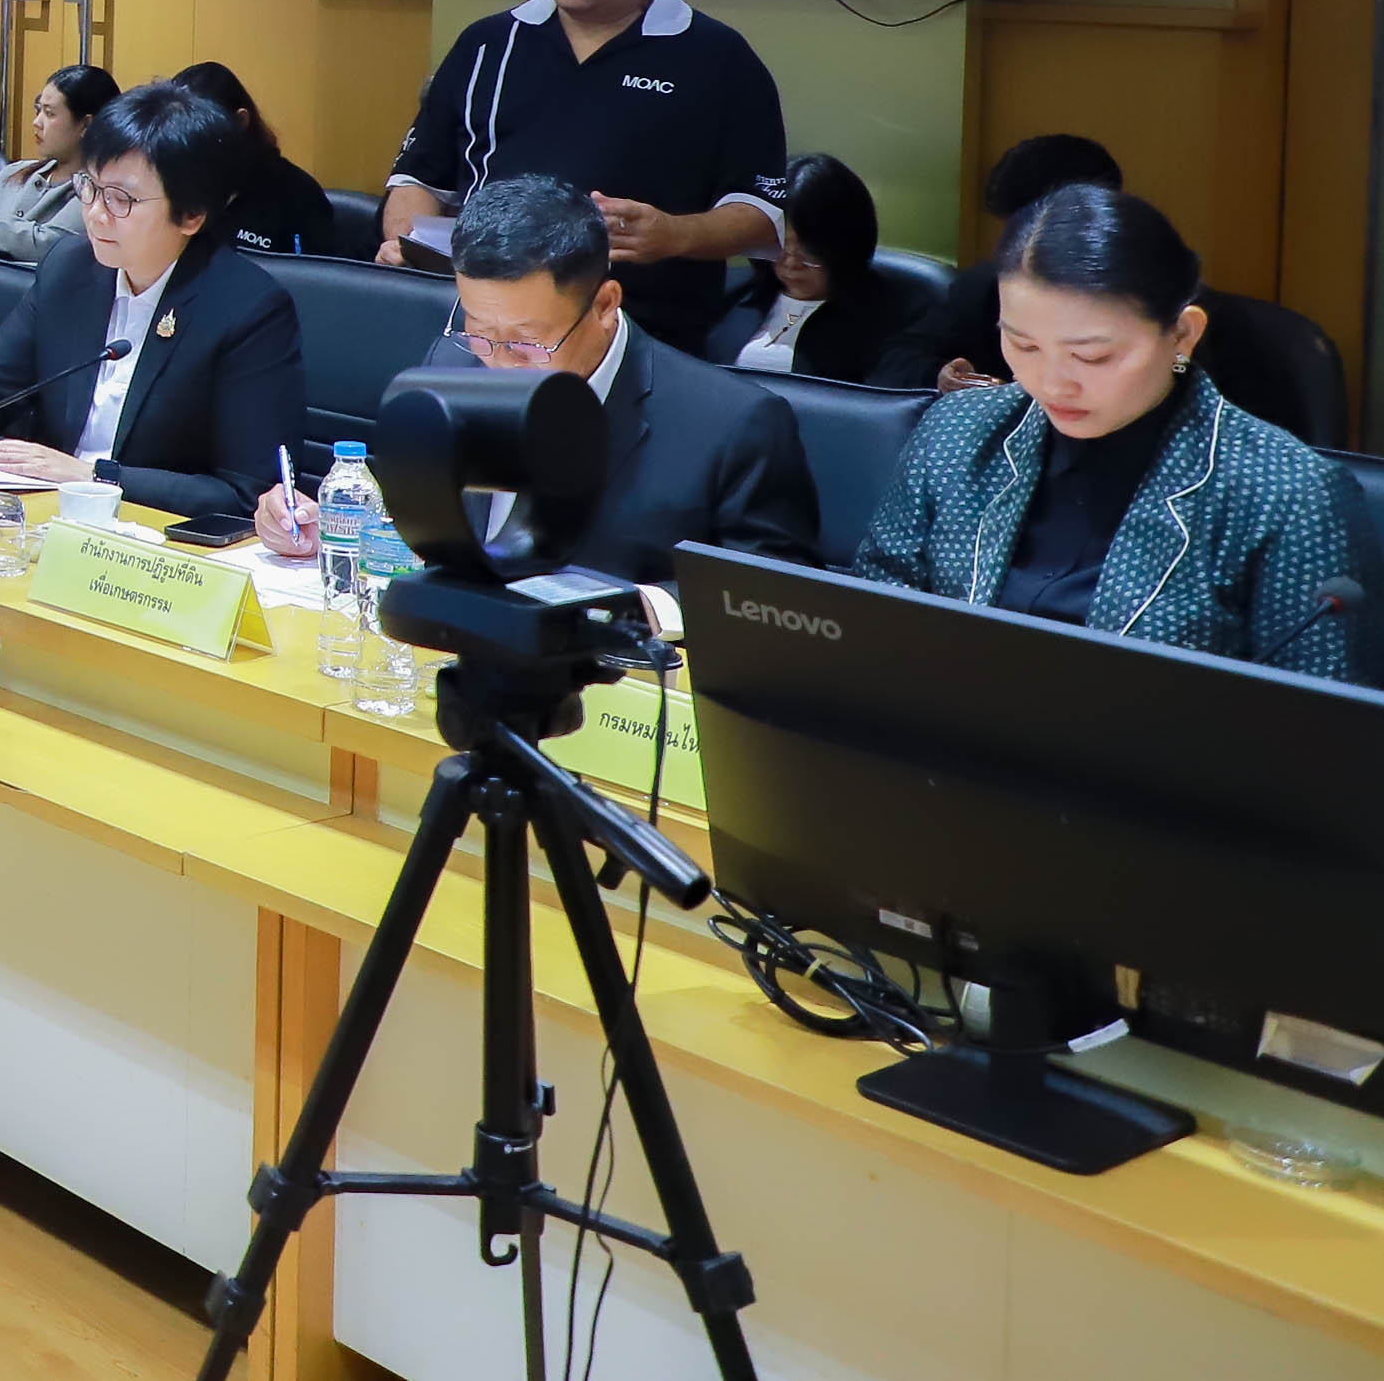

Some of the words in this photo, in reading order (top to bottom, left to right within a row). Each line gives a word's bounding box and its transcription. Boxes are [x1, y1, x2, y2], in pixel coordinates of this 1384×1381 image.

[622, 74, 674, 94] MOAC
[237, 229, 271, 249] MOAC
[80, 537, 204, 587] สำนักงานการปฏิรูปที่ดิน
[89, 570, 173, 613] เพื่อเกษตรกรรม
[722, 590, 842, 640] Lenovo
